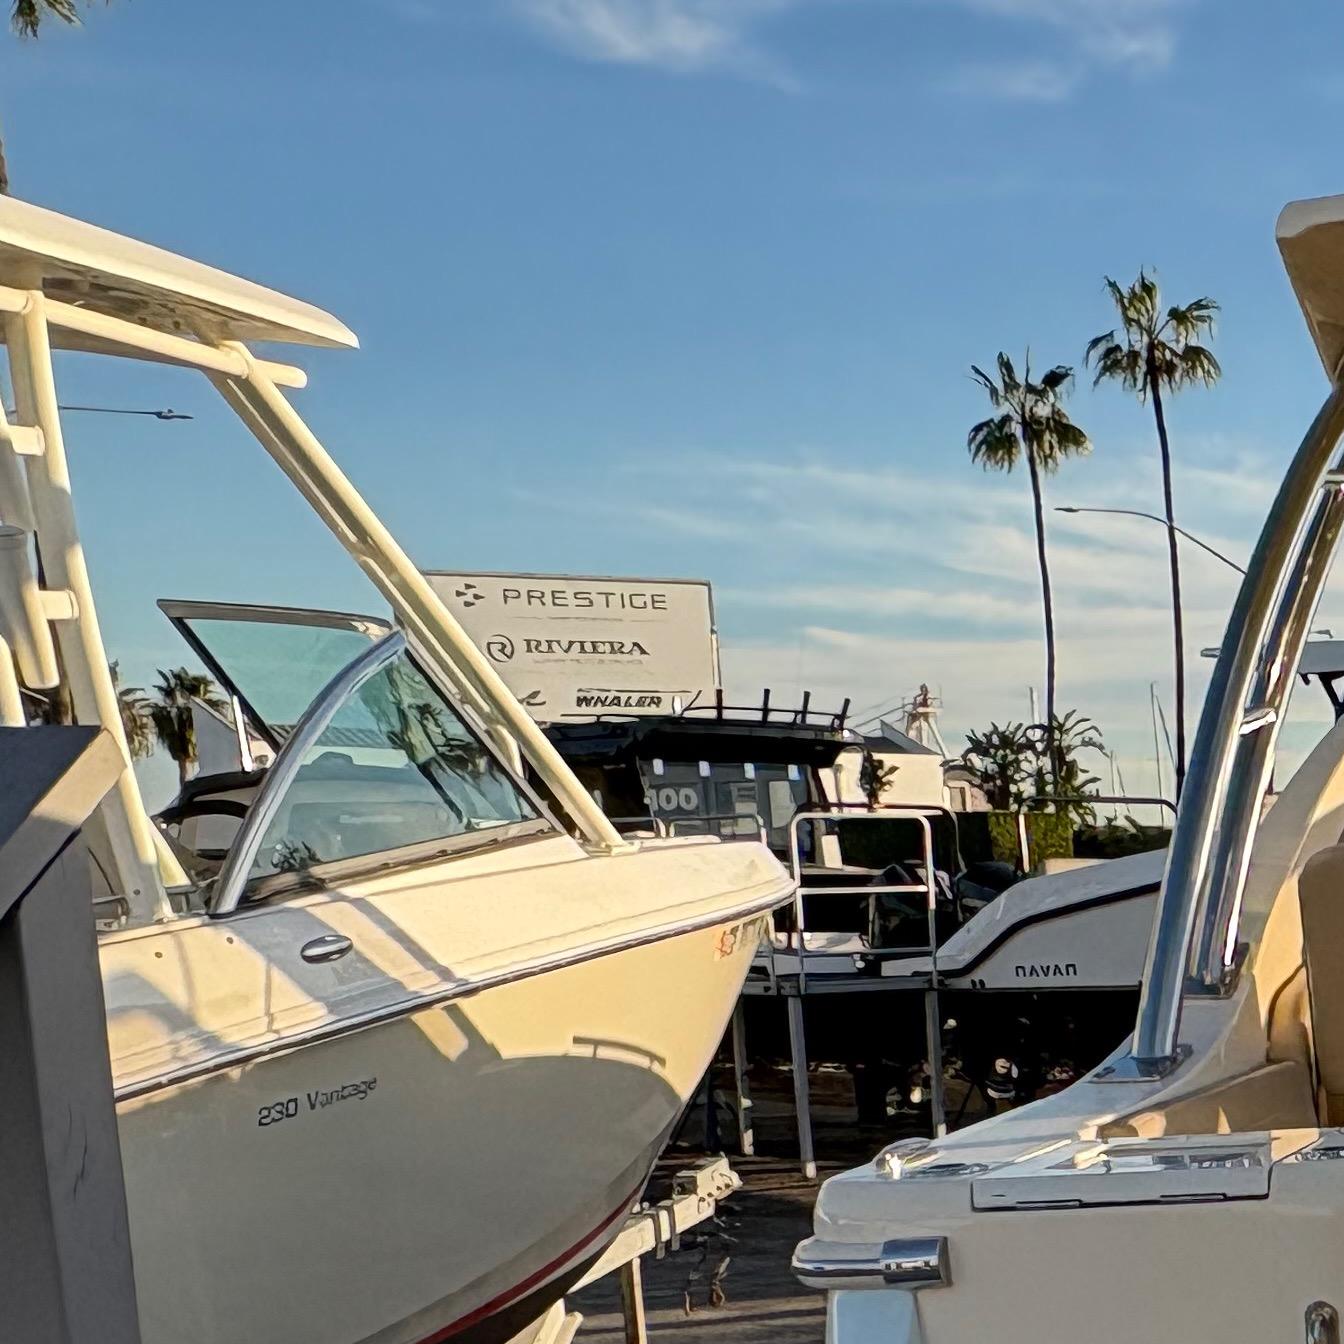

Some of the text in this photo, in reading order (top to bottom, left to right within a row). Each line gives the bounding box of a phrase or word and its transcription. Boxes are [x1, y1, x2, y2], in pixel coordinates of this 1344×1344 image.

[502, 587, 669, 611] PRESTIGE
[523, 638, 650, 656] RIVIERA
[258, 1097, 299, 1127] 230
